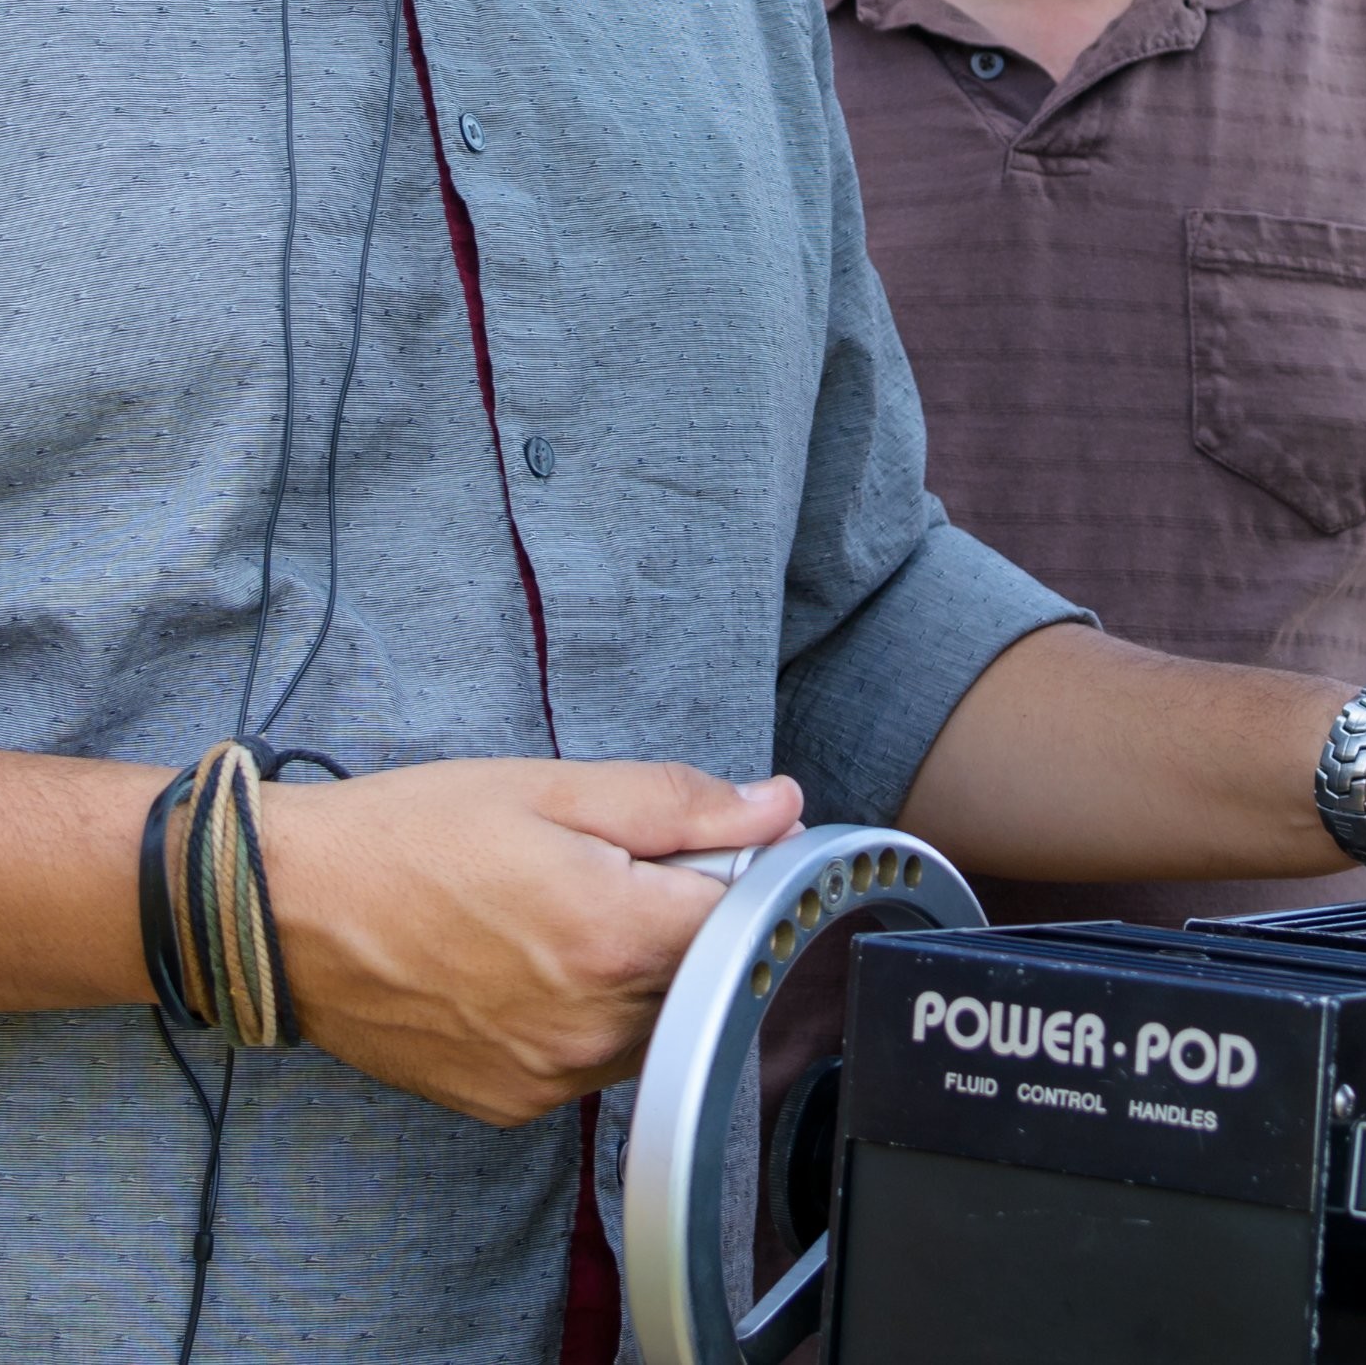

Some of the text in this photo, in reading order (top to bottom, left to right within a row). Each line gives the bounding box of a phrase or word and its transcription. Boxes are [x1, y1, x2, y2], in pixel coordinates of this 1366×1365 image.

[944, 1071, 1219, 1131] FLUID CONTROL HANDLES
